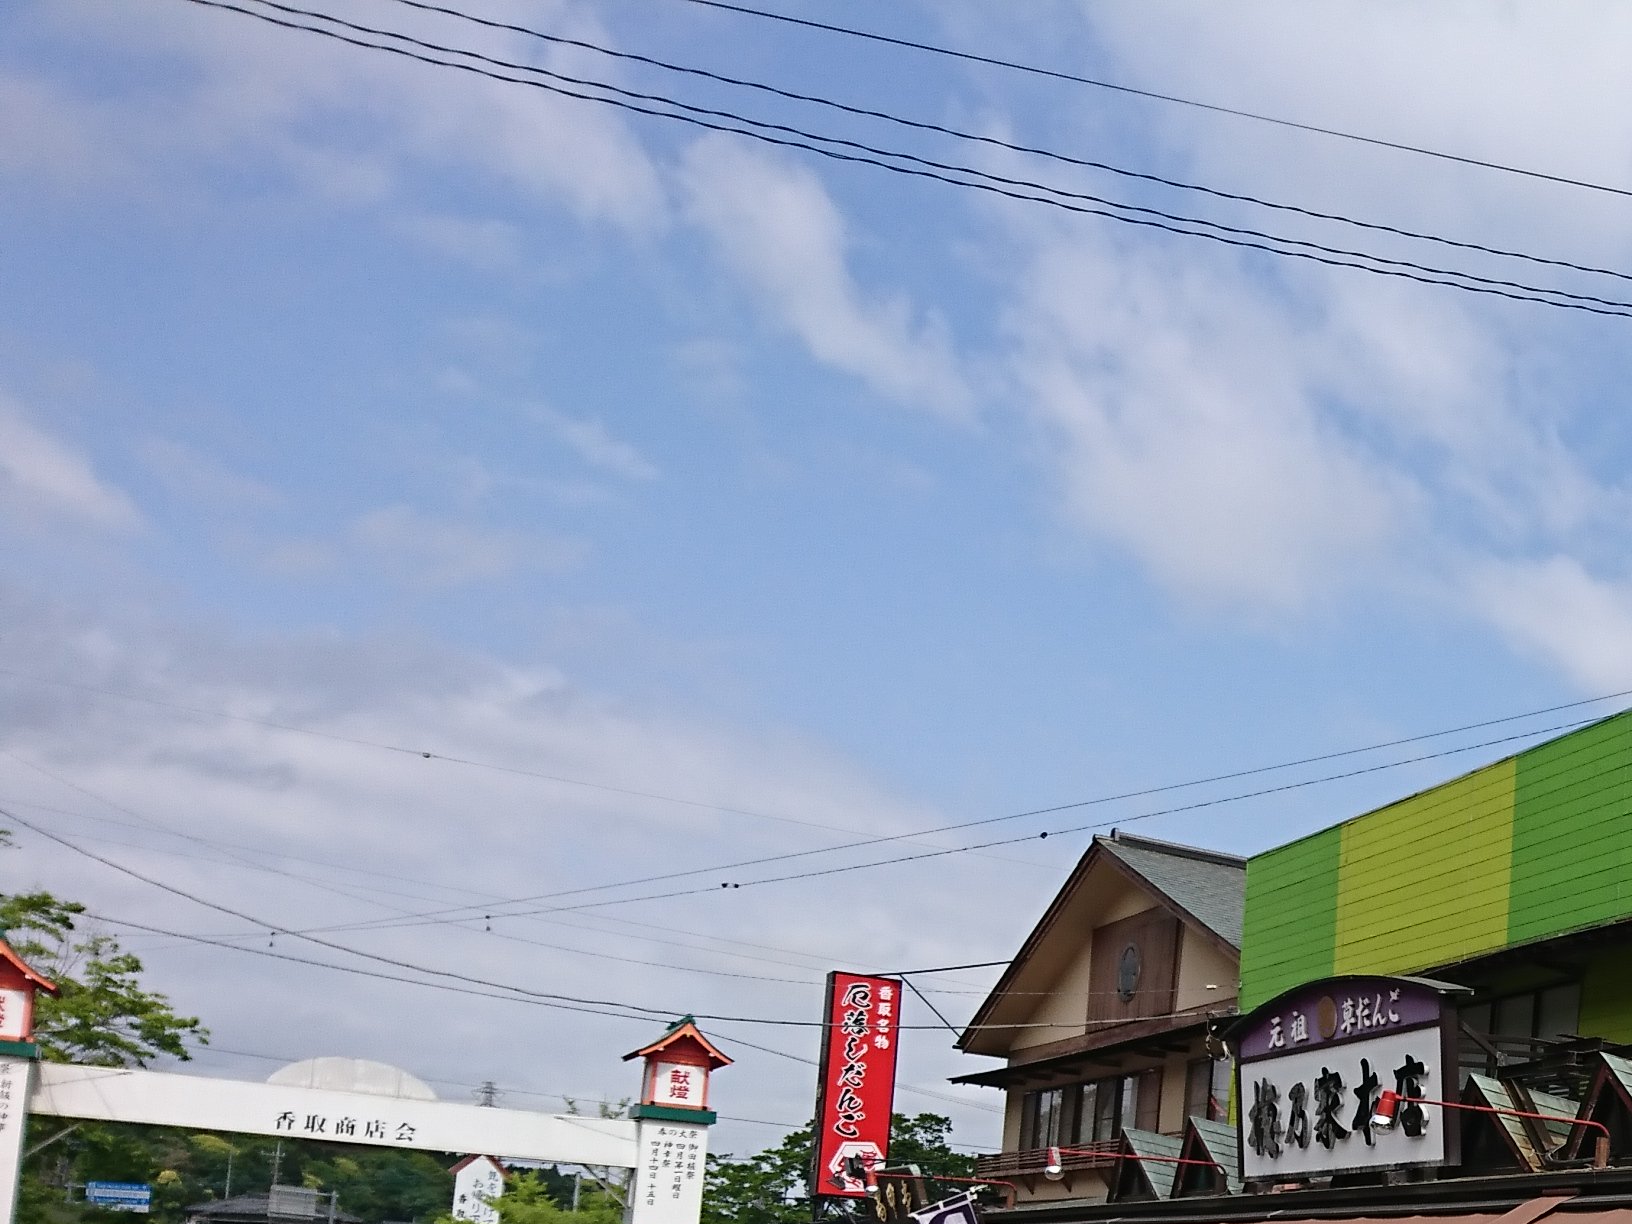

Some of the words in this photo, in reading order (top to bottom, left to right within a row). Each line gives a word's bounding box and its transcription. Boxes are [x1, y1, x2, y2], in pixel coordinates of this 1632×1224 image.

[874, 986, 893, 1050] 香取名物
[1268, 1013, 1308, 1049] 元祖
[1341, 988, 1401, 1034] 草だんご
[834, 983, 872, 1138] 厄落しだんご
[275, 1110, 417, 1142] 香取商店会
